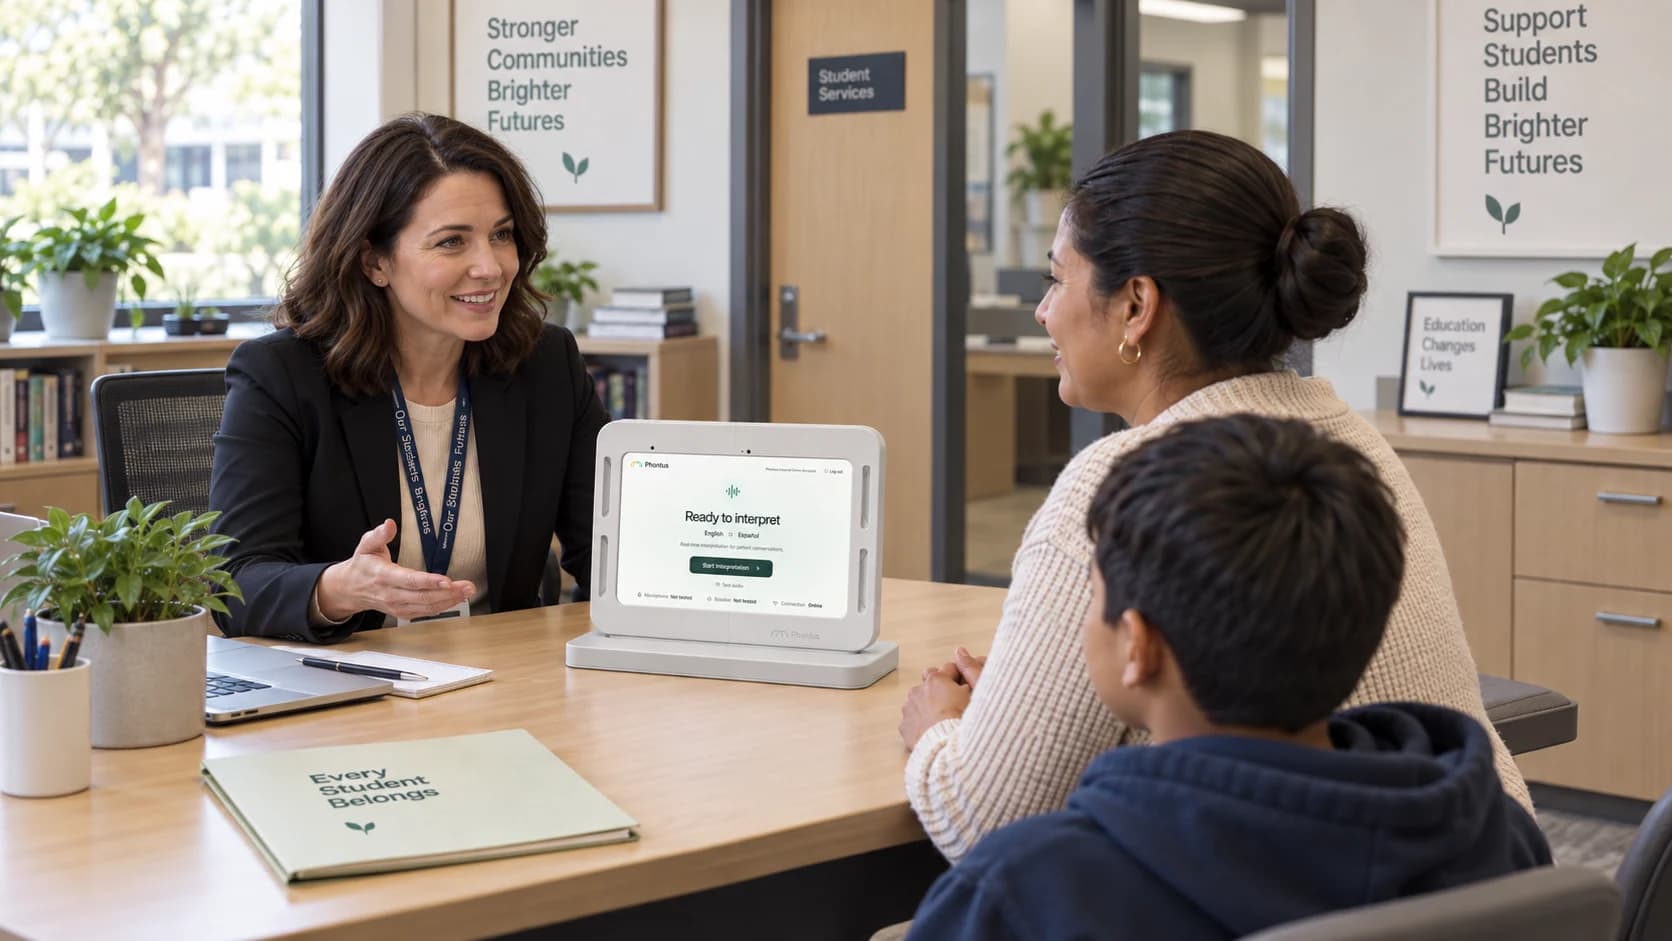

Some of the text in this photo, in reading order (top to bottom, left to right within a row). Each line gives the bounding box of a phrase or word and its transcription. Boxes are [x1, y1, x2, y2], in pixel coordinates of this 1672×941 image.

[487, 17, 579, 42] Stronger
[1484, 3, 1587, 37] Support
[487, 45, 628, 71] Communities
[1484, 40, 1597, 67] Students
[819, 67, 870, 84] Student
[487, 78, 572, 106] Brighter
[818, 85, 875, 102] Services
[1485, 75, 1547, 103] Build
[487, 110, 565, 132] Futures
[1485, 112, 1588, 144] Brighter
[1485, 149, 1583, 174] Futures
[1423, 317, 1486, 333] Education
[1422, 336, 1476, 356] Changes
[1420, 357, 1452, 372] Lives
[644, 461, 669, 469] Phontus
[685, 510, 780, 527] Ready to interpret
[704, 530, 760, 539] English Español
[309, 768, 387, 784] Every
[319, 775, 430, 796] Student
[328, 787, 440, 809] Belongs
